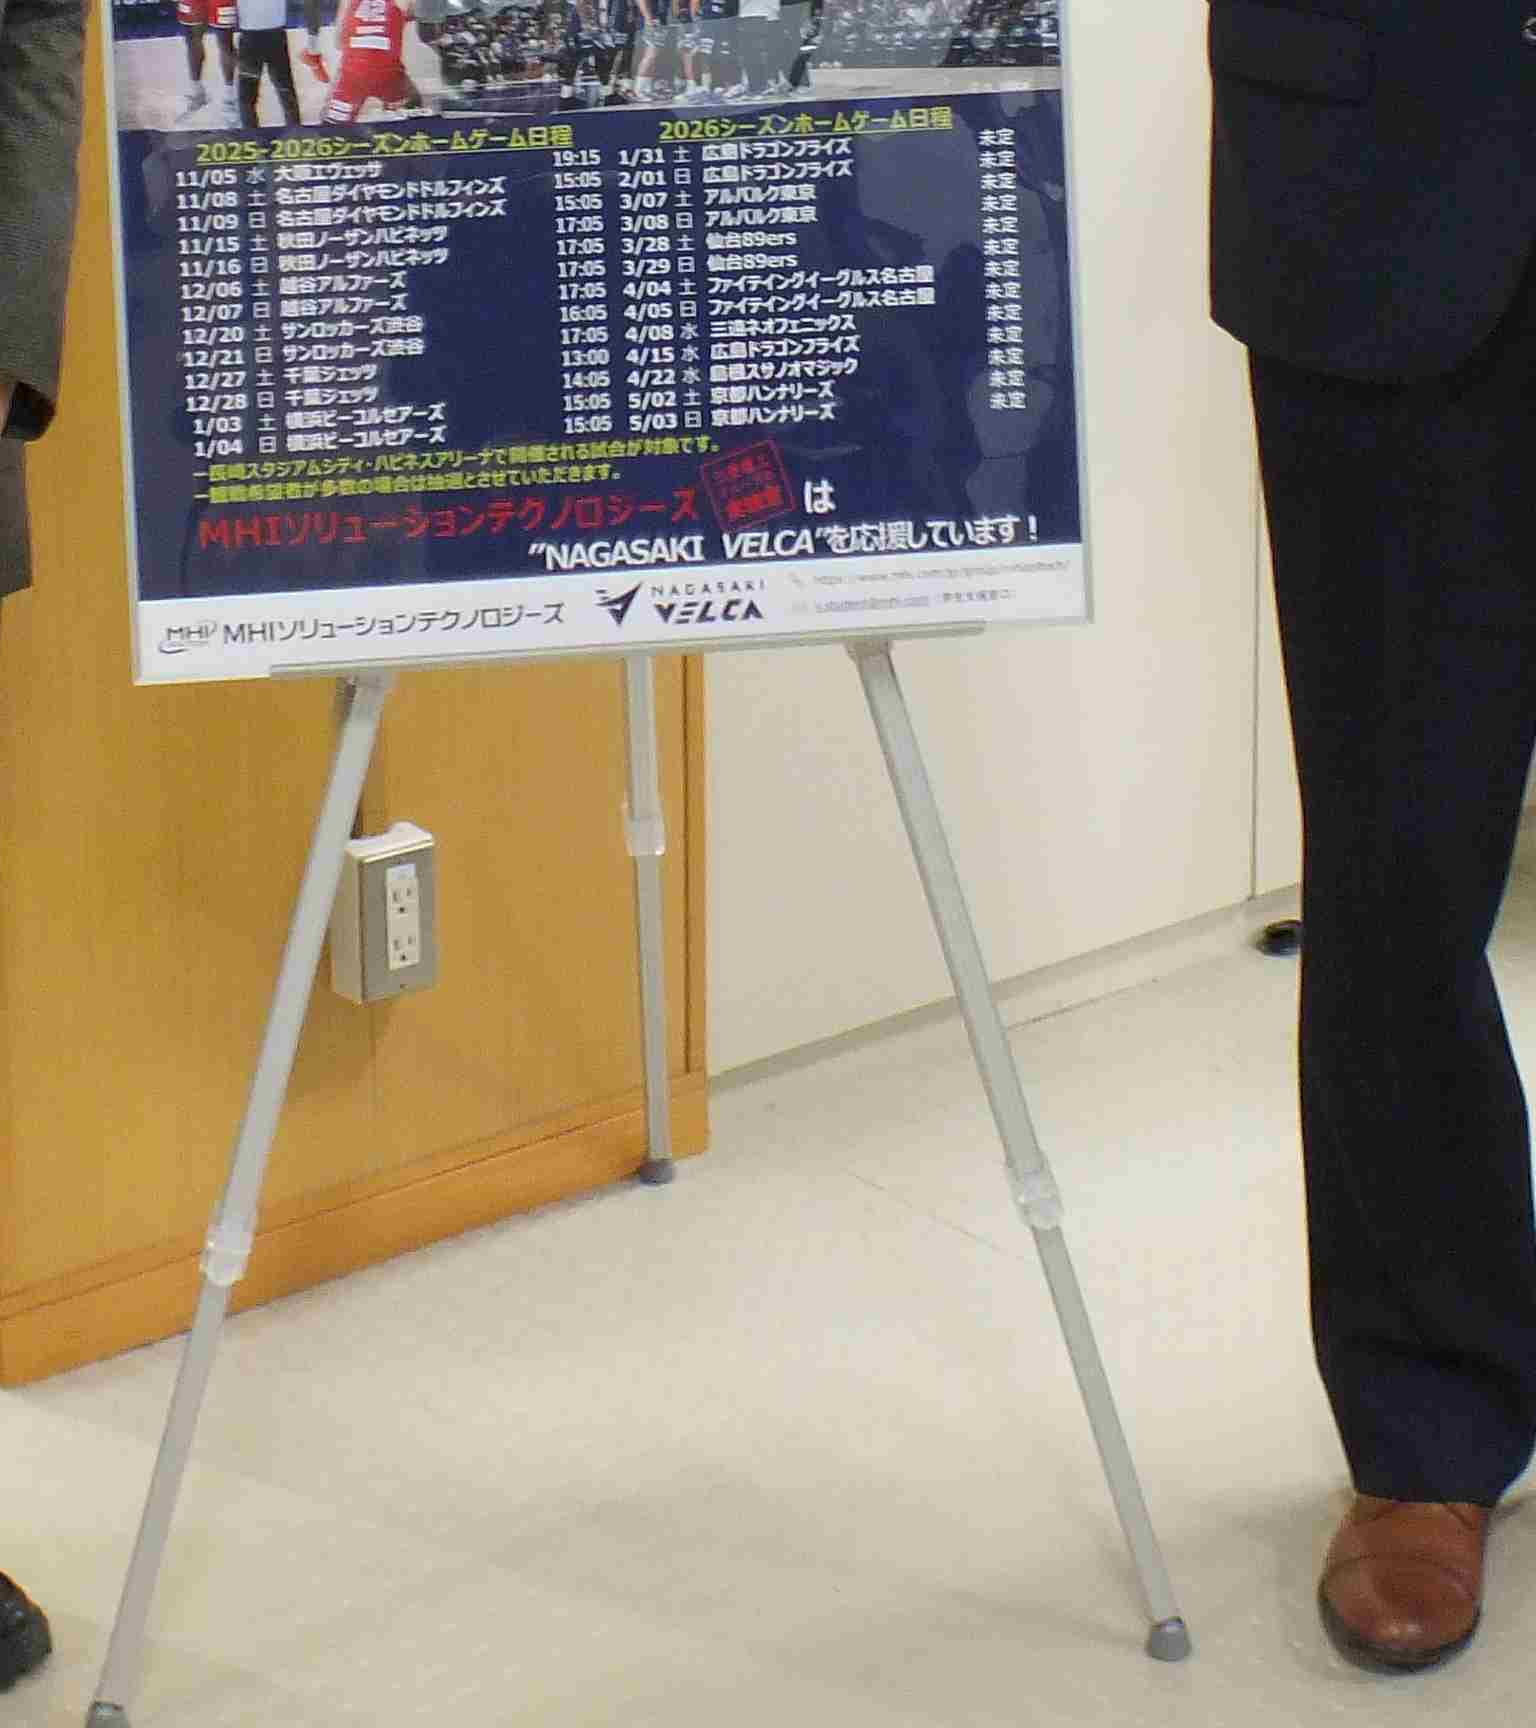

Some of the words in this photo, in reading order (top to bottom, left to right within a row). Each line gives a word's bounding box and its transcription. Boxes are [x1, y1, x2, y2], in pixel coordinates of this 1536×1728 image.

[619, 148, 665, 167] 1/31
[674, 146, 691, 163] 土
[979, 128, 1015, 146] 未定
[176, 168, 237, 188] 11/05
[246, 167, 265, 184] 水
[553, 149, 601, 167] 19:15
[618, 170, 666, 189] 2/01
[674, 168, 691, 185] 日
[979, 150, 1016, 169] 未定
[177, 190, 238, 211] 11/08
[247, 190, 267, 206] 土
[554, 171, 602, 189] 15:05
[620, 191, 668, 212] 3/07
[675, 190, 692, 207] 土
[980, 172, 1017, 190] 未定
[178, 213, 239, 233] 11/09
[249, 211, 266, 229] 日
[555, 193, 603, 212] 15:05
[620, 213, 669, 233] 3/08
[676, 212, 693, 229] 日
[980, 193, 1018, 213] 未定
[179, 236, 240, 255] 11/15
[250, 234, 269, 252] 土
[555, 215, 604, 234] 17:05
[621, 236, 671, 255] 3/28
[677, 234, 694, 251] 土
[982, 215, 1019, 234] 未定
[179, 258, 242, 278] 11/16
[251, 256, 268, 274] 日
[557, 237, 605, 256] 17:05
[622, 258, 671, 278] 3/29
[678, 256, 695, 273] 日
[983, 237, 1019, 256] 未定
[181, 280, 243, 301] 12/06
[252, 279, 270, 297] 土
[557, 259, 606, 278] 17:05
[623, 280, 672, 300] 4/04
[679, 278, 697, 296] 土
[984, 259, 1020, 278] 未定
[181, 303, 243, 323] 12/07
[253, 301, 270, 318] 日
[559, 281, 607, 300] 17:05
[623, 302, 673, 322] 4/05
[680, 300, 697, 317] 日
[985, 281, 1022, 300] 未定
[182, 326, 245, 346] 12/20
[254, 324, 272, 342] 土
[560, 304, 608, 323] 16:05
[625, 324, 674, 344] 4/08
[680, 322, 699, 340] 水
[987, 303, 1023, 322] 未定
[182, 349, 245, 369] 12/21
[255, 346, 273, 363] 日
[561, 326, 609, 345] 17:05
[625, 346, 675, 366] 4/15
[681, 345, 699, 362] 水
[987, 325, 1024, 344] 未定
[185, 370, 247, 391] 12/27
[256, 369, 275, 386] 土
[562, 348, 610, 367] 13:00
[627, 368, 676, 388] 4/22
[682, 367, 701, 384] 水
[988, 346, 1024, 366] 未定
[186, 393, 248, 413] 12/28
[257, 391, 274, 409] 日
[563, 370, 611, 389] 14:05
[628, 390, 677, 410] 5/02
[683, 388, 701, 406] 土
[989, 369, 1025, 388] 未定
[194, 416, 243, 436] 1/03
[258, 413, 277, 431] 土
[563, 392, 611, 412] 15:05
[629, 412, 678, 433] 5/03
[684, 410, 701, 428] 日
[990, 390, 1026, 410] 未定
[195, 439, 243, 459] 1/04
[259, 435, 277, 454] 日
[564, 415, 612, 434] 15:05
[803, 477, 836, 514] は
[650, 578, 765, 597] NAGASAKI
[223, 602, 566, 646] MHIソリューションテクノロジーズ
